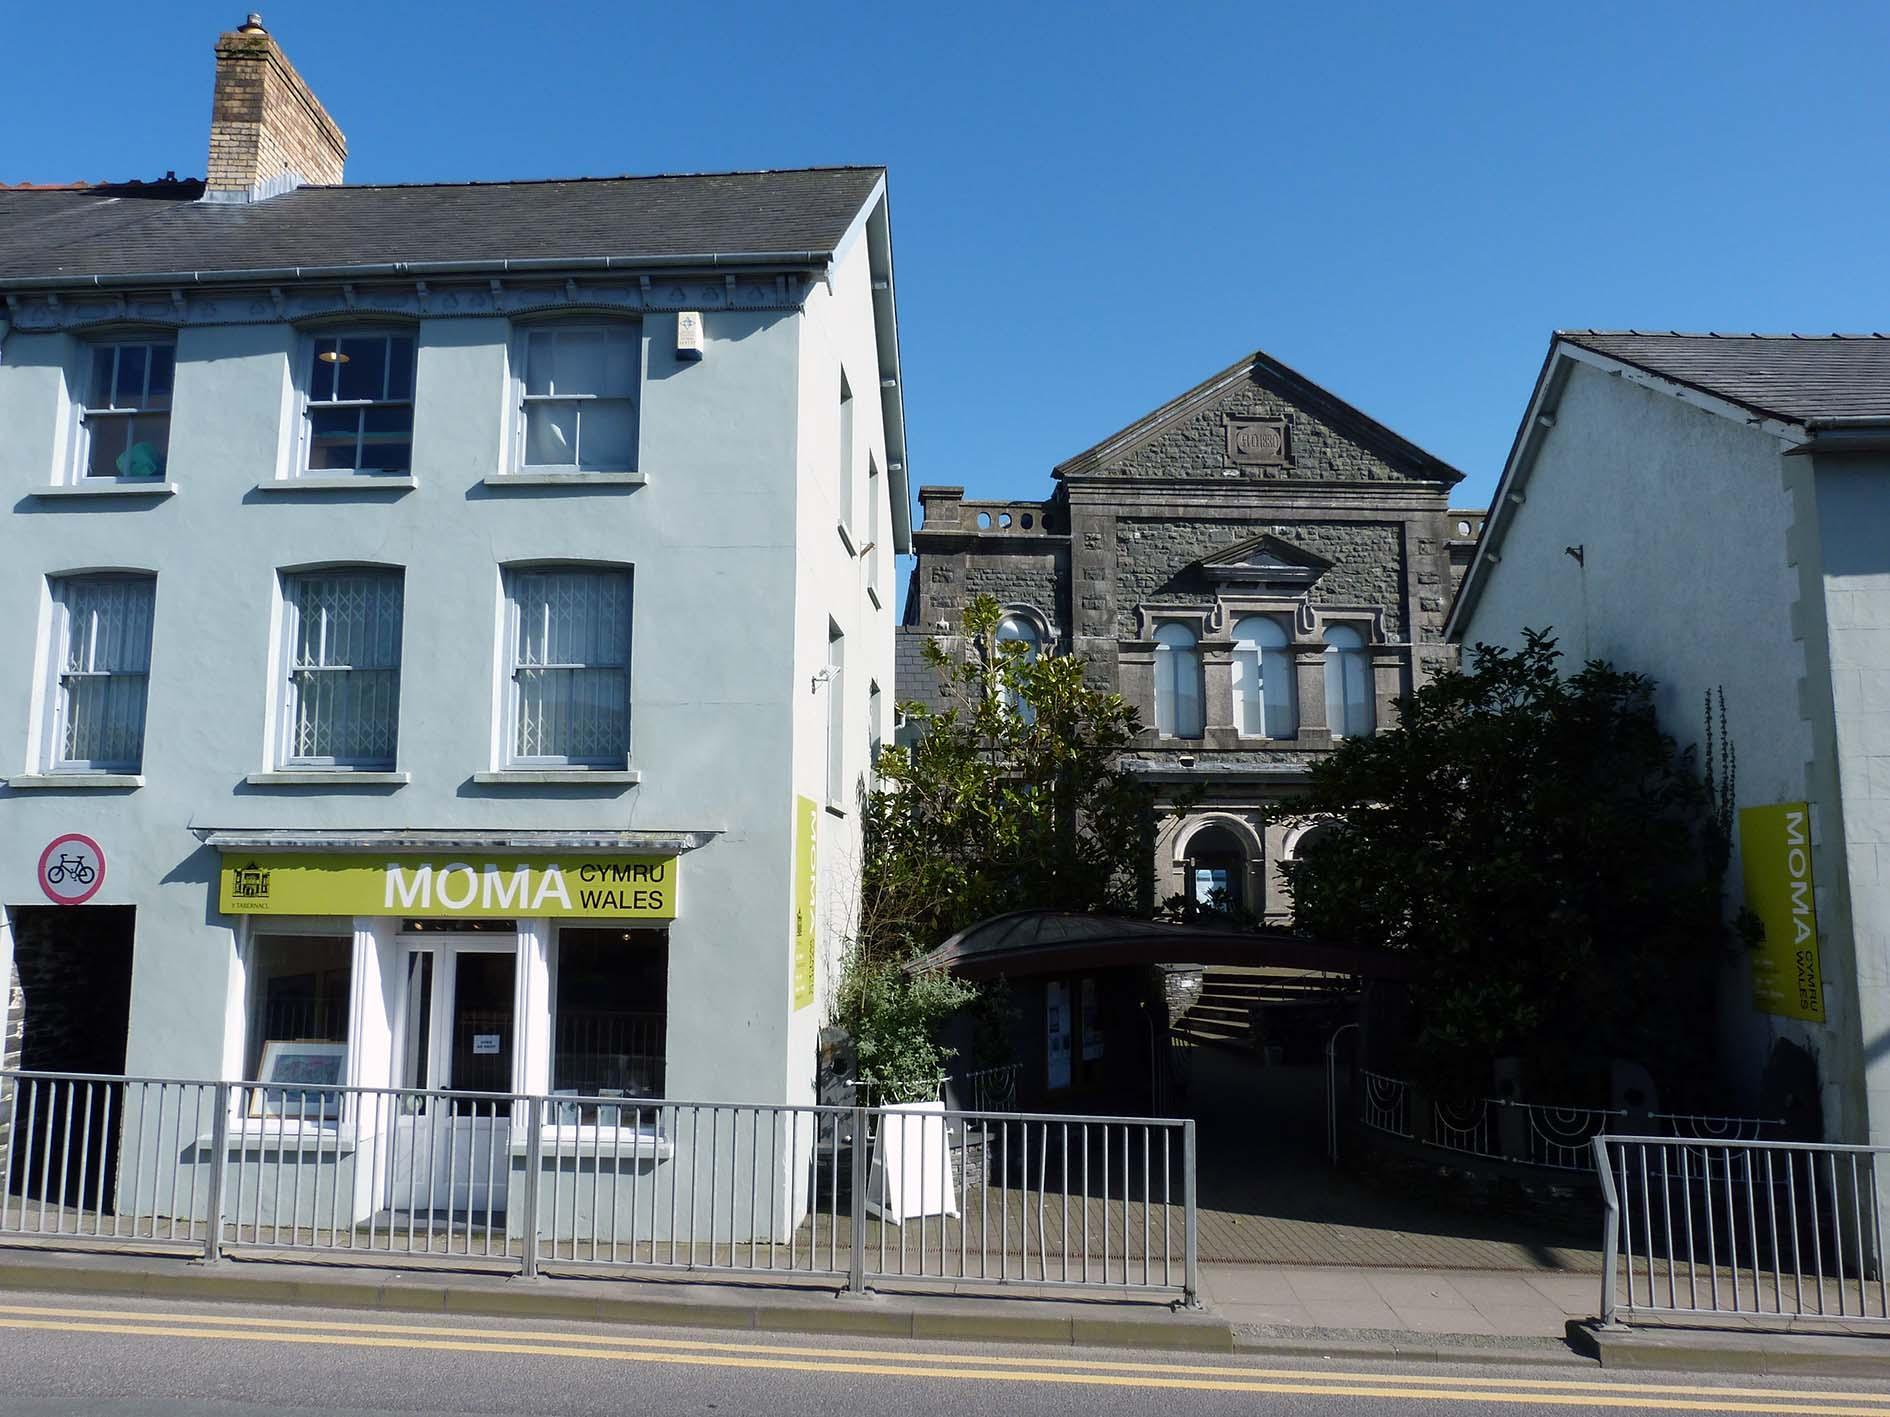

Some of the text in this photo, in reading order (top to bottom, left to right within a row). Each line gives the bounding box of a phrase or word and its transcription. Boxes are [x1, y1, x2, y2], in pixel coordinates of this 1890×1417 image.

[383, 862, 573, 910] MOMA
[579, 863, 665, 883] CYMRU
[580, 890, 664, 910] WALES
[1785, 811, 1811, 944] MOMA
[1796, 950, 1809, 1010] WALES
[1805, 950, 1818, 1012] CYMRU
